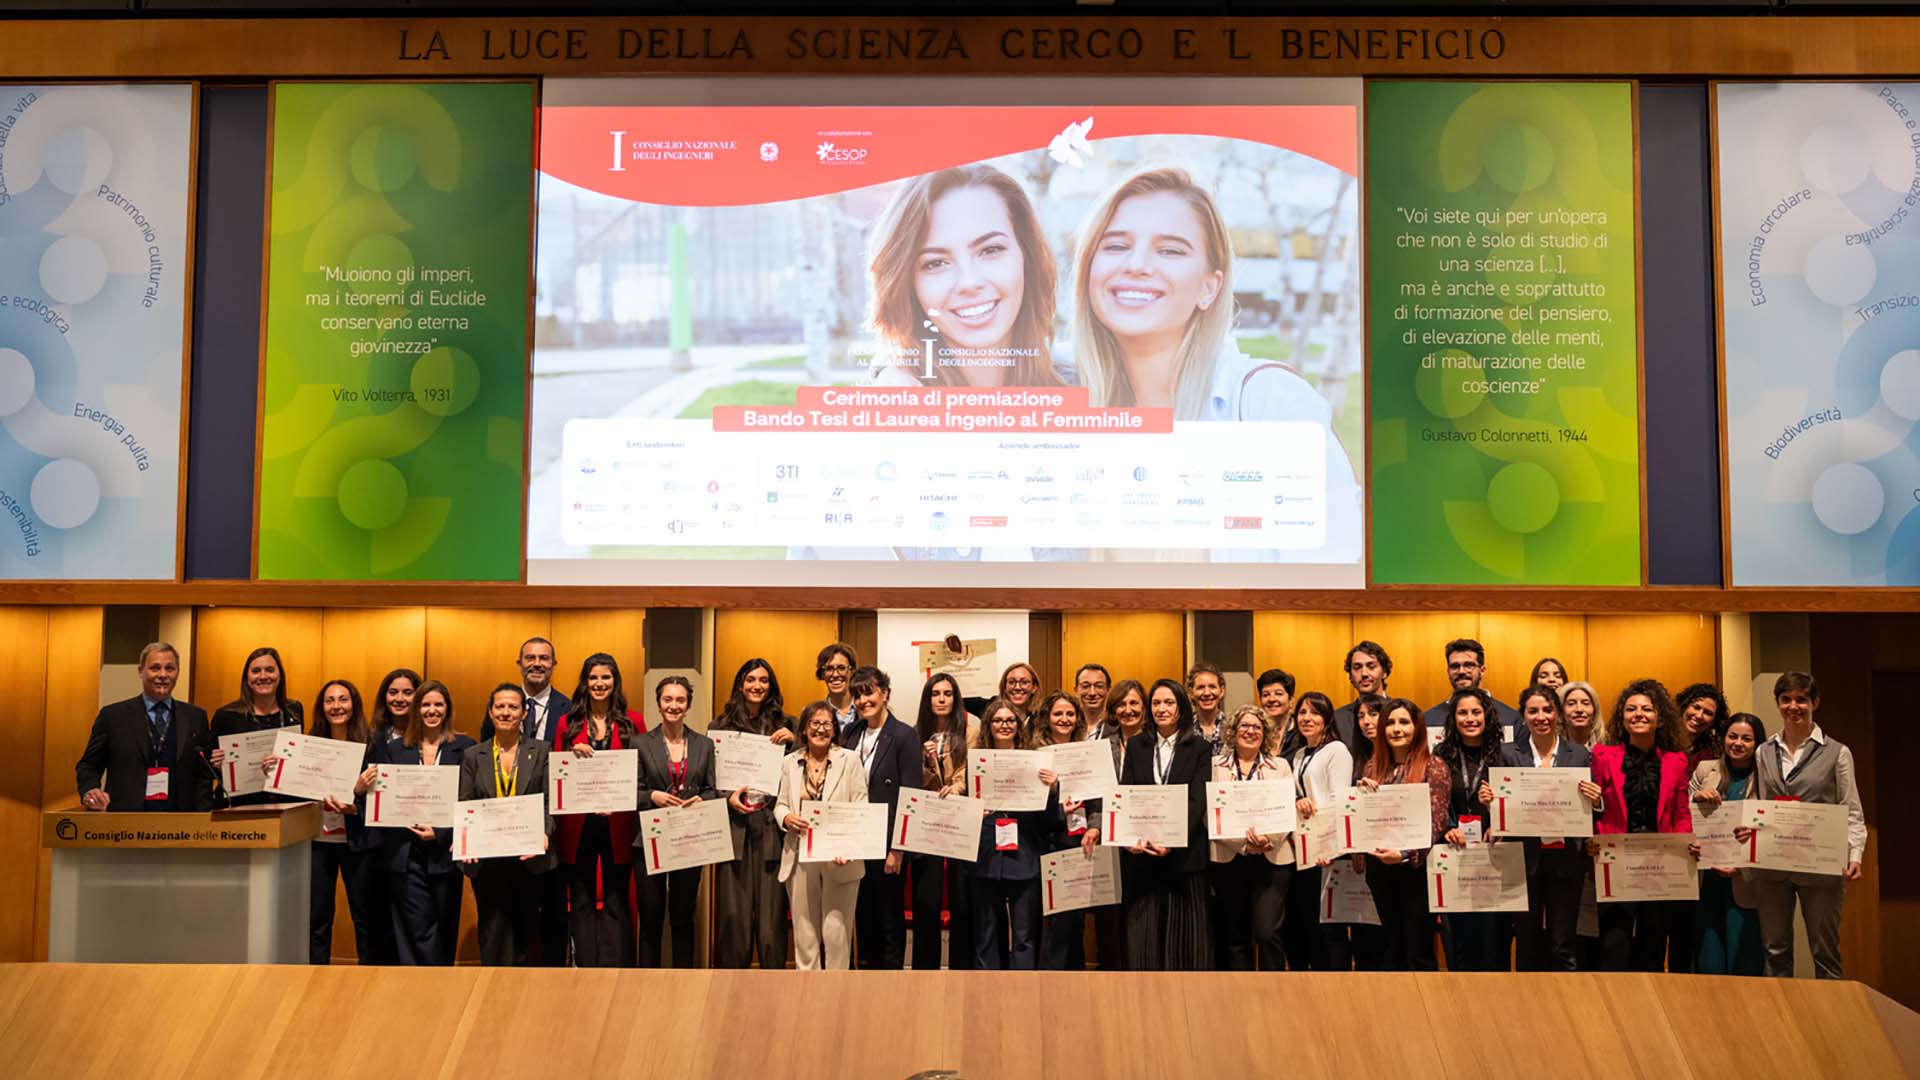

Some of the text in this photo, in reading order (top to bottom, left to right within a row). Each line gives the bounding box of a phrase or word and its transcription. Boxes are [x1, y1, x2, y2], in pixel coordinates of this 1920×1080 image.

[400, 29, 450, 60] LA
[482, 29, 588, 60] LUCE
[617, 28, 755, 60] DELLA
[786, 28, 968, 60] SCIENZA
[1001, 28, 1143, 60] CERCO
[1173, 28, 1196, 60] E
[1281, 28, 1506, 61] BENEFICIO
[13, 91, 38, 114] vita
[1878, 86, 1909, 119] Pace
[1906, 119, 1916, 130] e
[633, 141, 737, 150] CONSIGLIO NAZIONALE
[826, 149, 868, 161] CESOP
[633, 151, 714, 160] DEGLI INGEGNERI
[1397, 207, 1608, 228] "Voi siete qui per un'opera
[1845, 208, 1908, 246] scientifica
[98, 184, 164, 309] Patrimonio culturale
[1396, 231, 1608, 248] che non è solo di studio di
[1748, 188, 1812, 307] Economia circolare
[1439, 258, 1470, 272] una
[1475, 255, 1534, 272] scienza
[319, 266, 474, 285] "Muoiono gli imperi,
[305, 290, 487, 306] ma i teoremi di Euclide
[1400, 280, 1606, 299] ma è anche e soprattutto
[13, 296, 70, 334] ecologica
[1394, 305, 1612, 324] di formazione del pensiero,
[1855, 292, 1920, 321] Transizio
[321, 315, 469, 330] conservano eterna
[1402, 329, 1605, 347] di elevazione delle menti,
[350, 338, 438, 358] giovinezza"
[938, 348, 1040, 357] CONSIGLIO NAZIONALE
[1421, 353, 1586, 370] di maturazione delle
[332, 388, 358, 402] Vito
[424, 388, 451, 402] 1931
[1462, 378, 1546, 394] coscienze"
[823, 390, 1065, 411] Cerimonia di premiazione
[744, 410, 1143, 431] Bando Tesi di Laurea Ingenio al Femminile
[74, 402, 150, 472] Energia pulita
[1422, 428, 1588, 444] Gustavo Colonnetti, 1944
[1764, 406, 1842, 460] Biodiversità
[775, 464, 800, 479] 3TI
[84, 830, 267, 842] Consiglio Nazionale delle Ricerche
